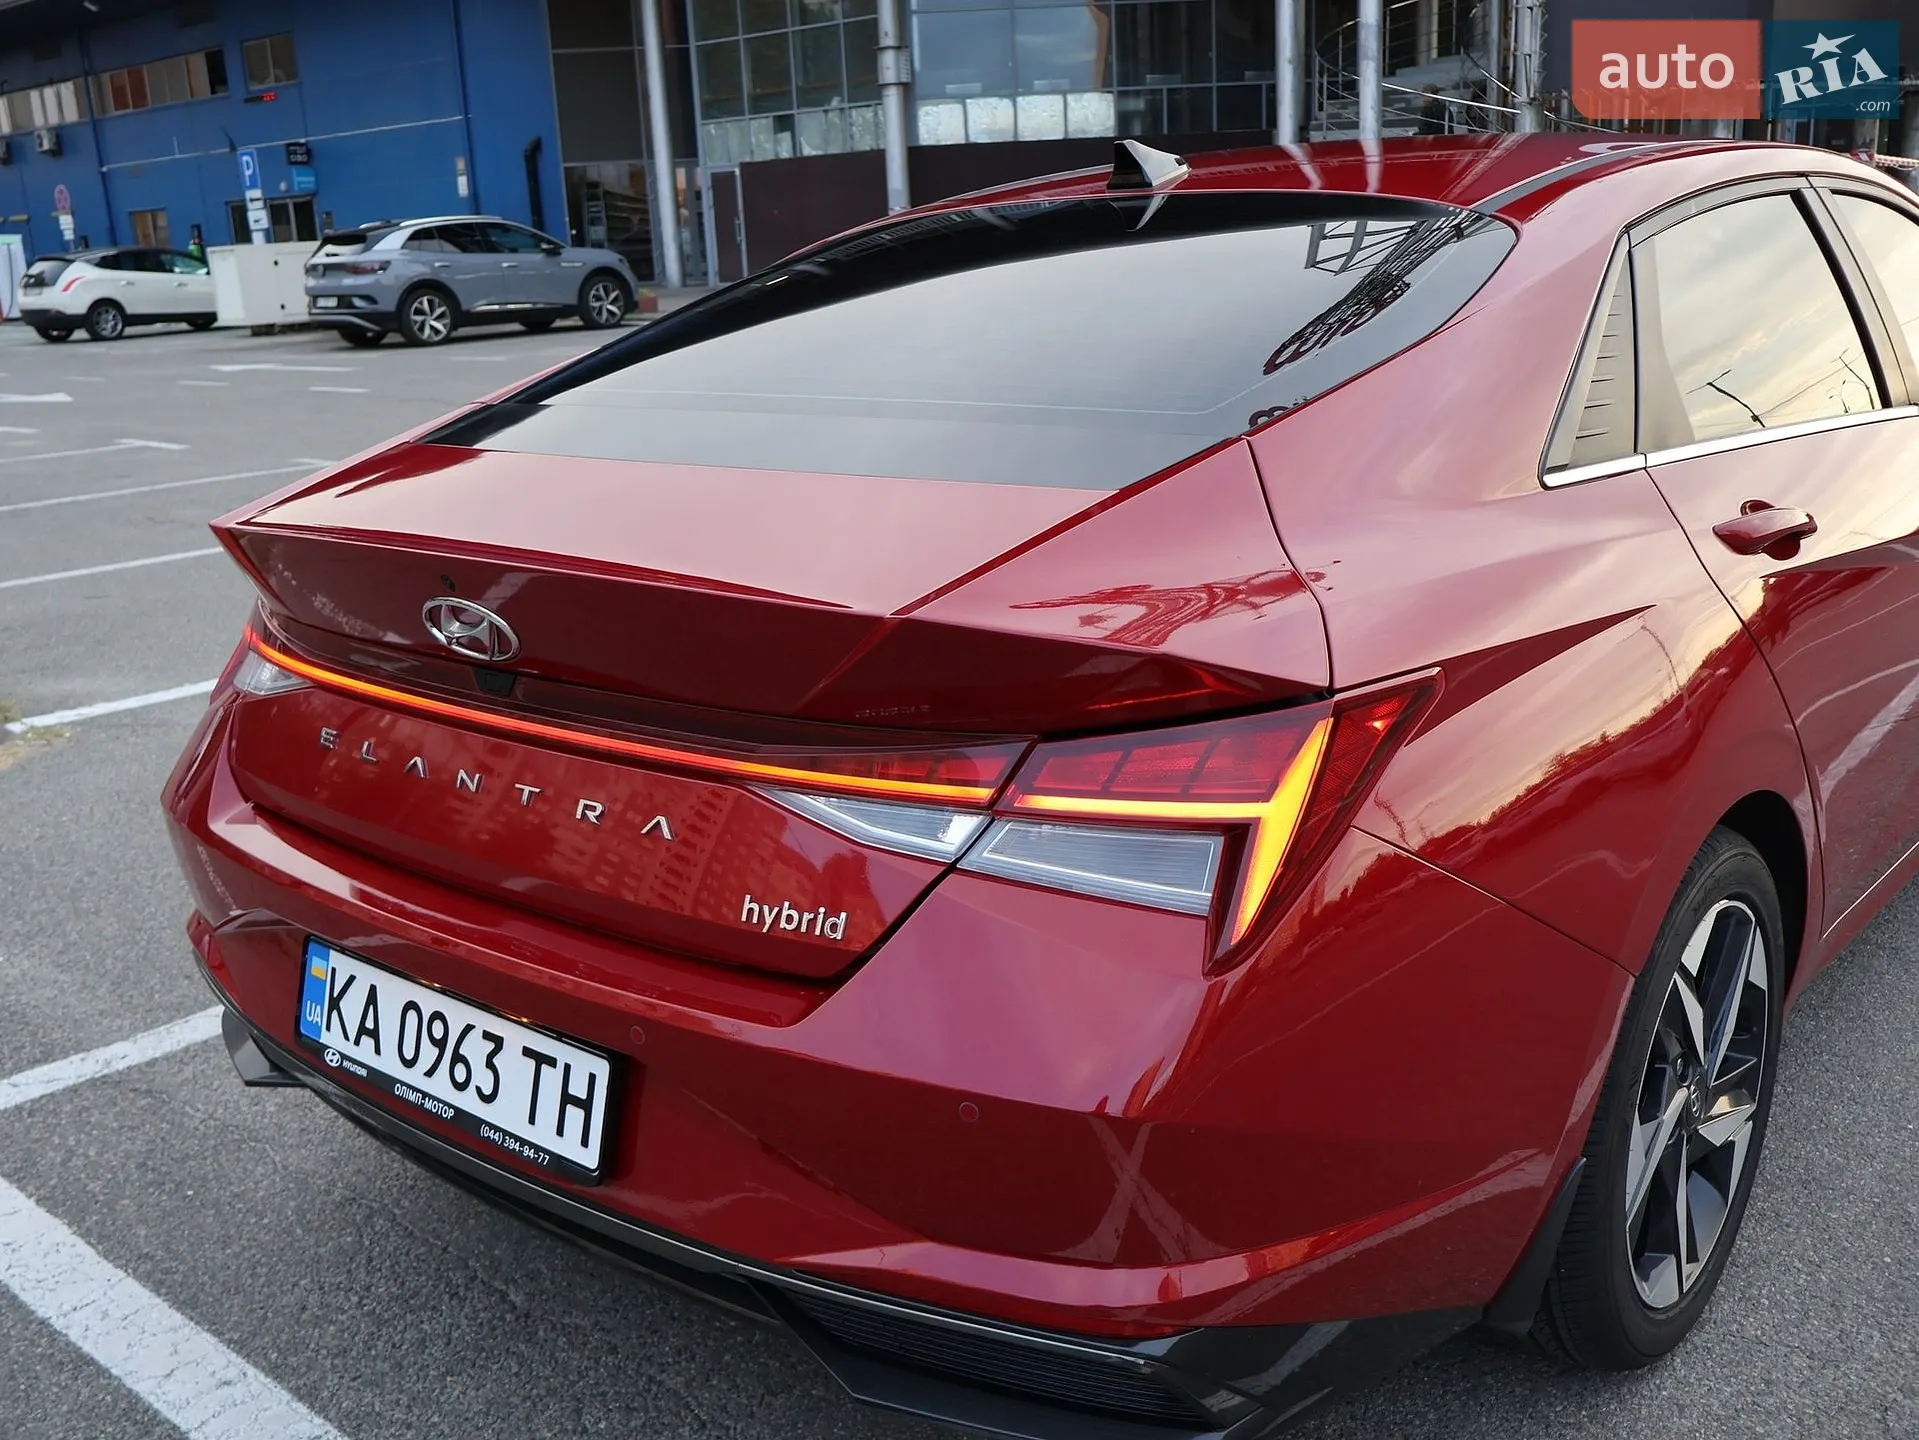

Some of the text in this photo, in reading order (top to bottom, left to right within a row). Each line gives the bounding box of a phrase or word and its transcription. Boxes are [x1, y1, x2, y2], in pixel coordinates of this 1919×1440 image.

[242, 155, 254, 187] P
[319, 727, 674, 841] ELANTRA
[741, 894, 847, 941] hybrid
[306, 1000, 322, 1027] UA
[325, 967, 598, 1149] KA 0963 TH
[342, 1060, 368, 1078] HYUNDAI
[394, 1083, 455, 1120] ОЛІМП-МОТОР
[480, 1123, 550, 1166] (044) 394-94-77
